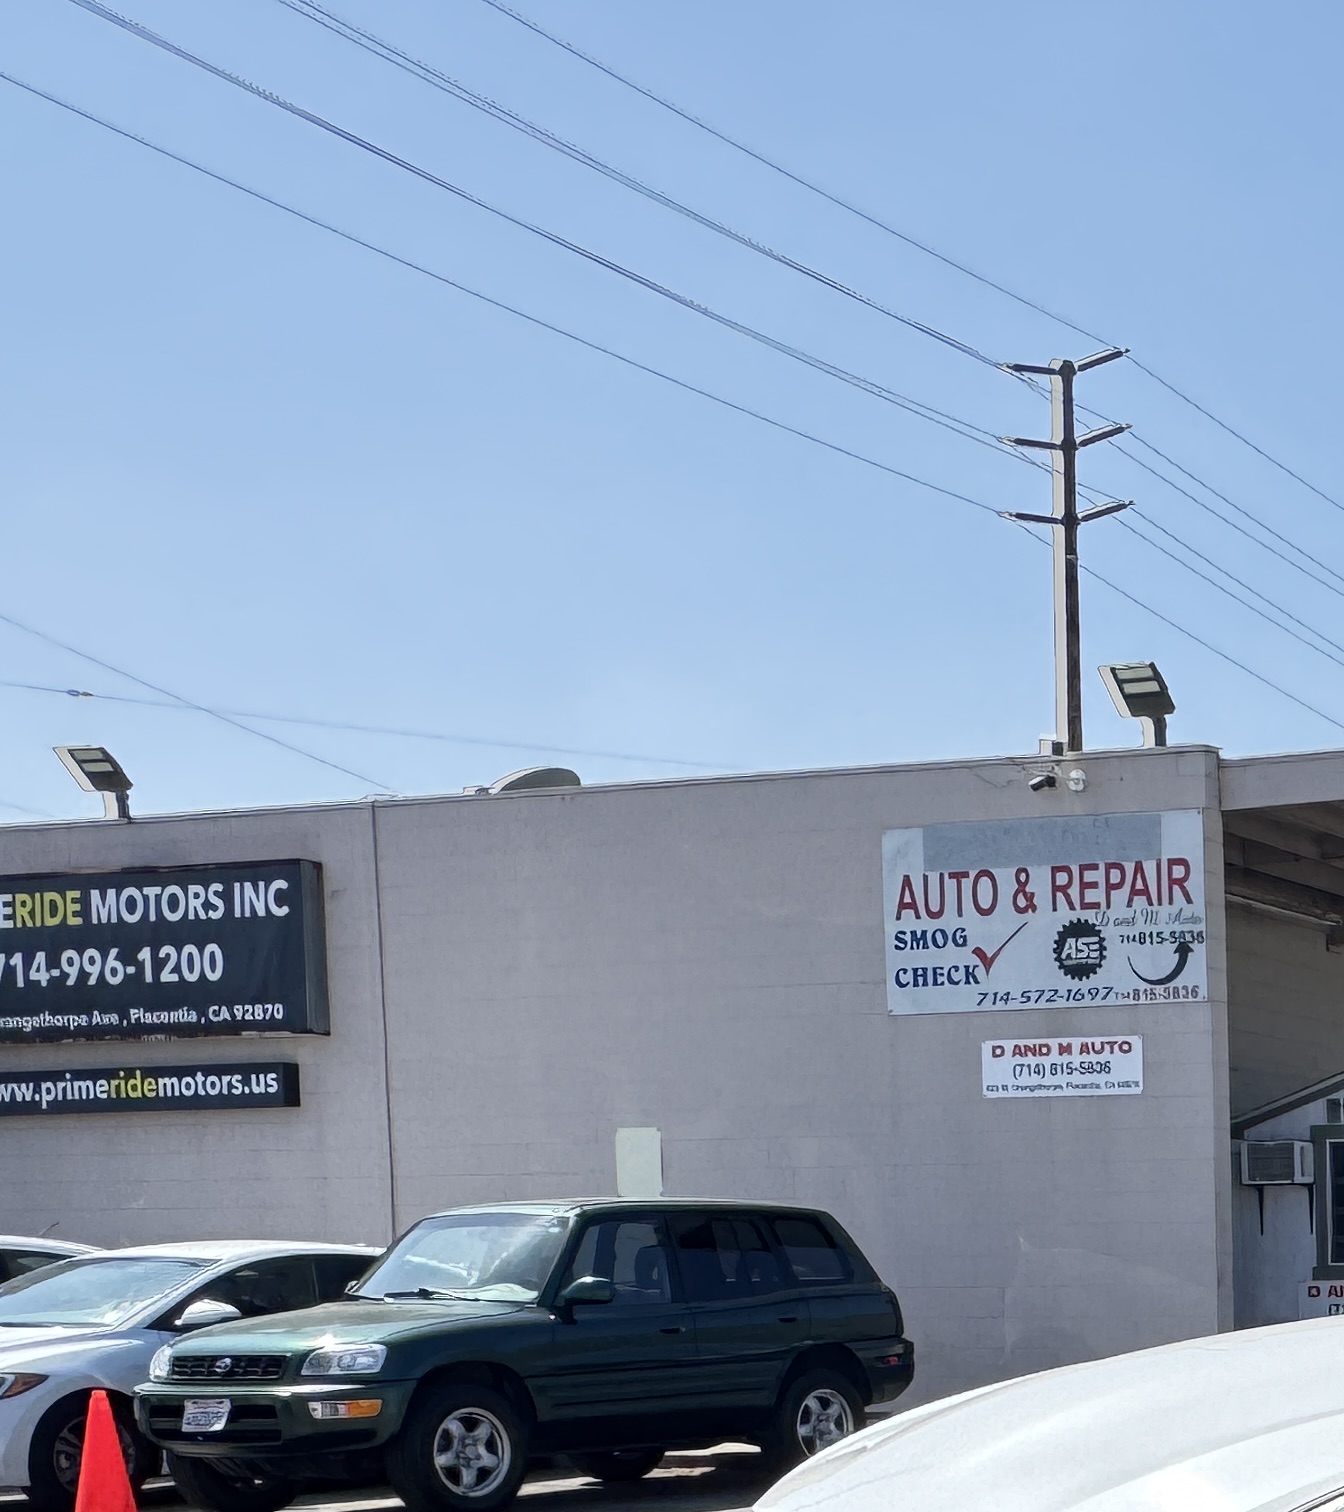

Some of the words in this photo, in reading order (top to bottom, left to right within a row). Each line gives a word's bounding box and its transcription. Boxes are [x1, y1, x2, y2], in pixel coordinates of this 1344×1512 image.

[895, 869, 999, 921] AUTO
[1012, 867, 1037, 914] &
[1051, 857, 1194, 912] REPAIR
[90, 882, 225, 925] MOTORS
[233, 879, 291, 918] INC
[894, 927, 968, 951] SMOG
[1060, 937, 1100, 960] ASE
[895, 964, 981, 989] CHECK
[976, 986, 1114, 1006] 714-572-1697
[208, 1004, 229, 1022] CA
[234, 1003, 284, 1021] 92870
[991, 1045, 1006, 1058] D
[1012, 1043, 1051, 1058] AND
[1058, 1042, 1073, 1056] M
[1079, 1040, 1133, 1056] AUTO
[1012, 1063, 1047, 1080] (714)
[1308, 1285, 1322, 1298] D
